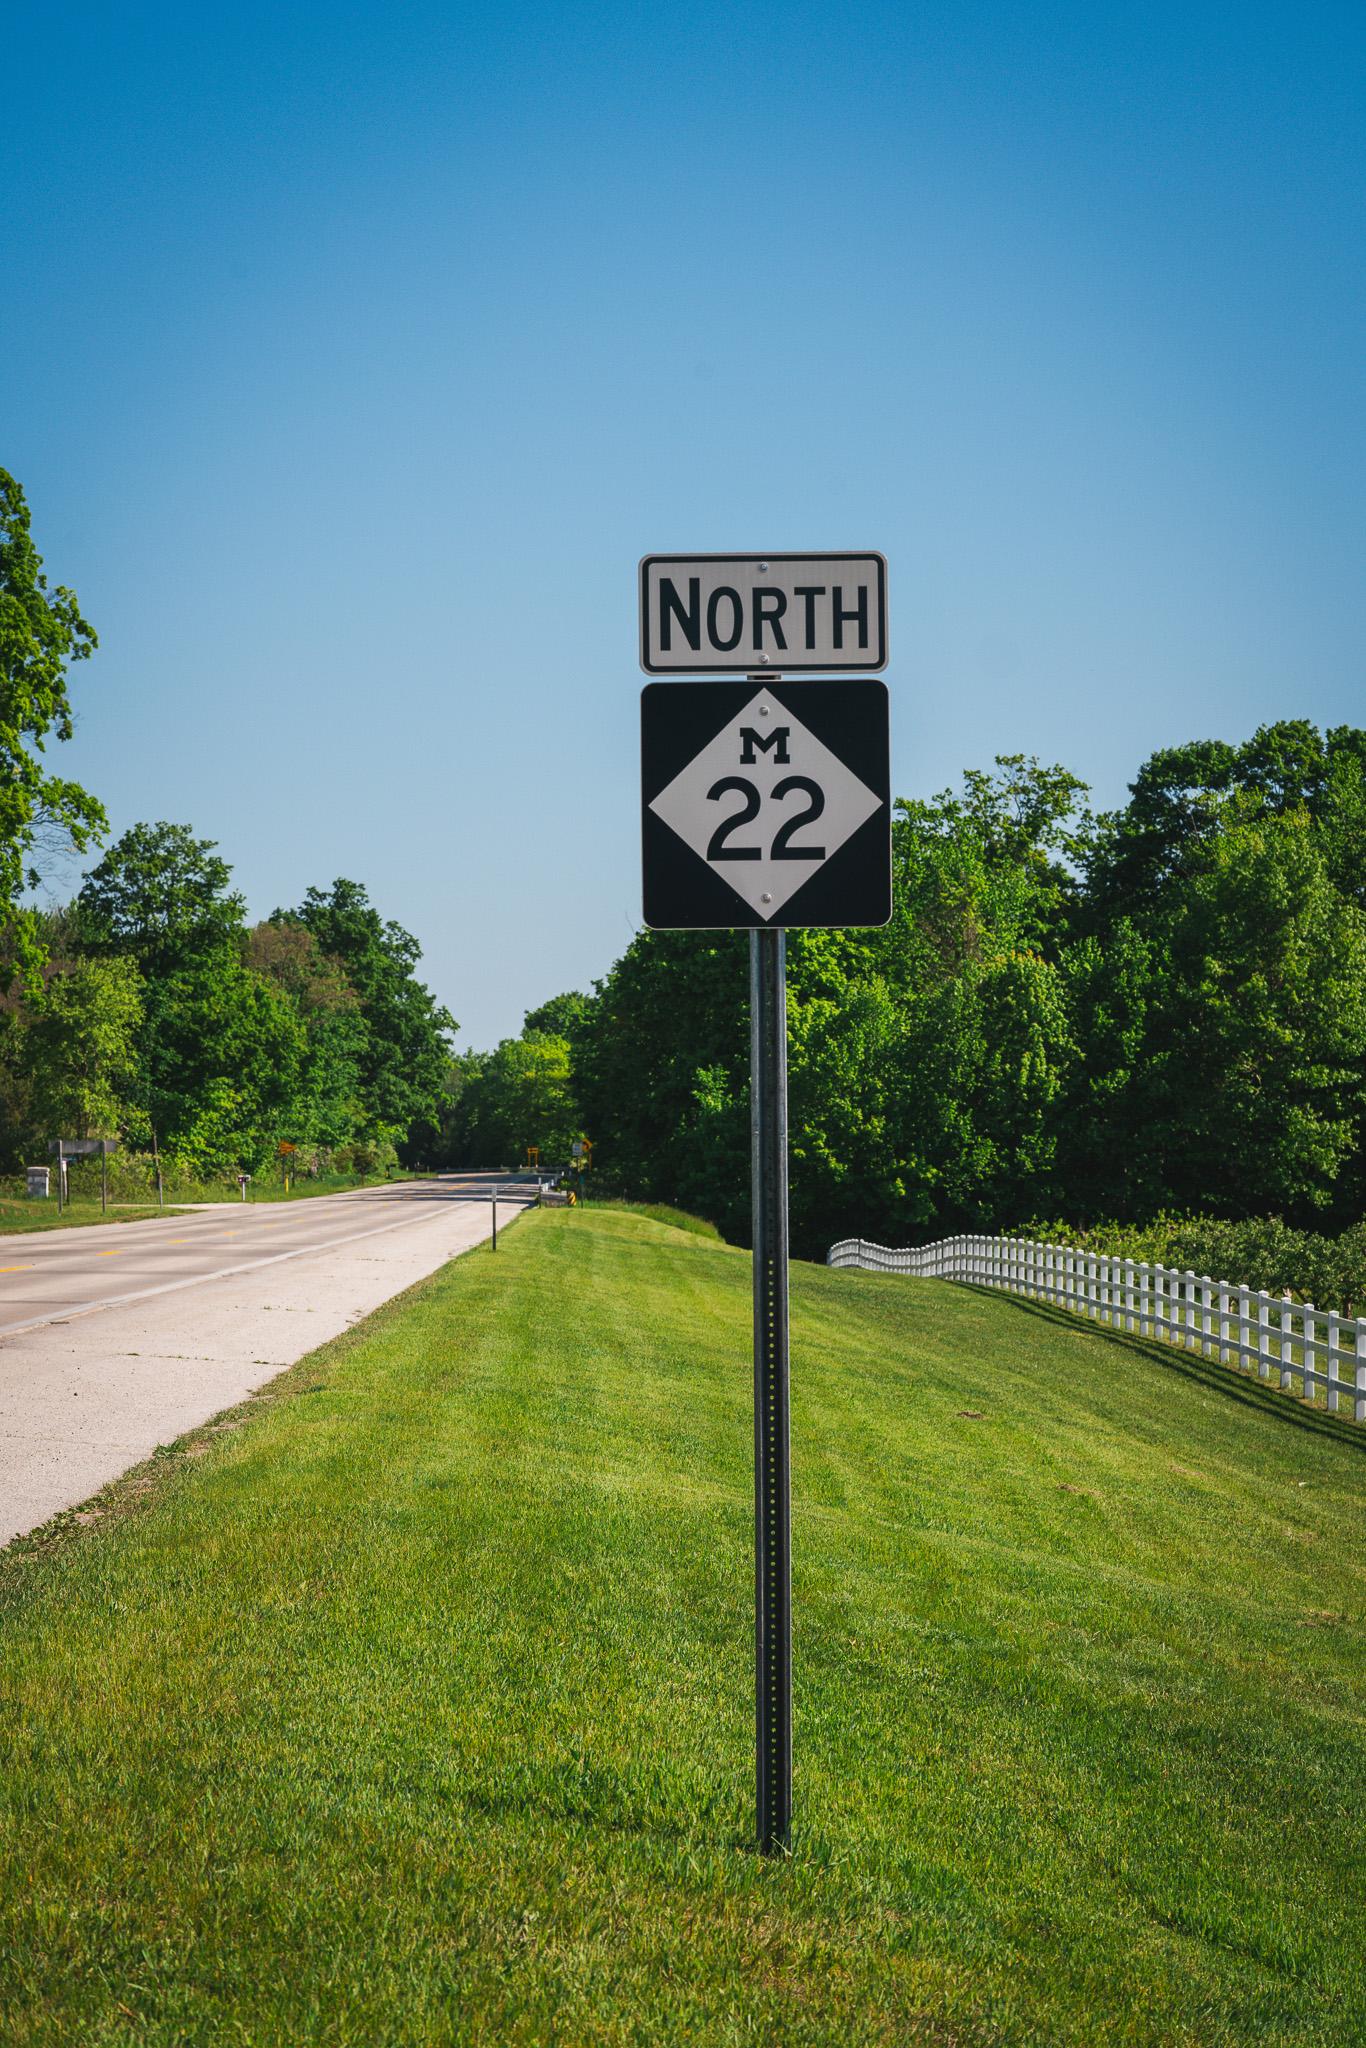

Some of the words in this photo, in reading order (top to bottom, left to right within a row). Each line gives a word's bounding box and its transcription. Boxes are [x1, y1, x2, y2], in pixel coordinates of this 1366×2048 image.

[659, 577, 869, 652] NORTH
[739, 726, 791, 765] M
[706, 775, 826, 861] 22
